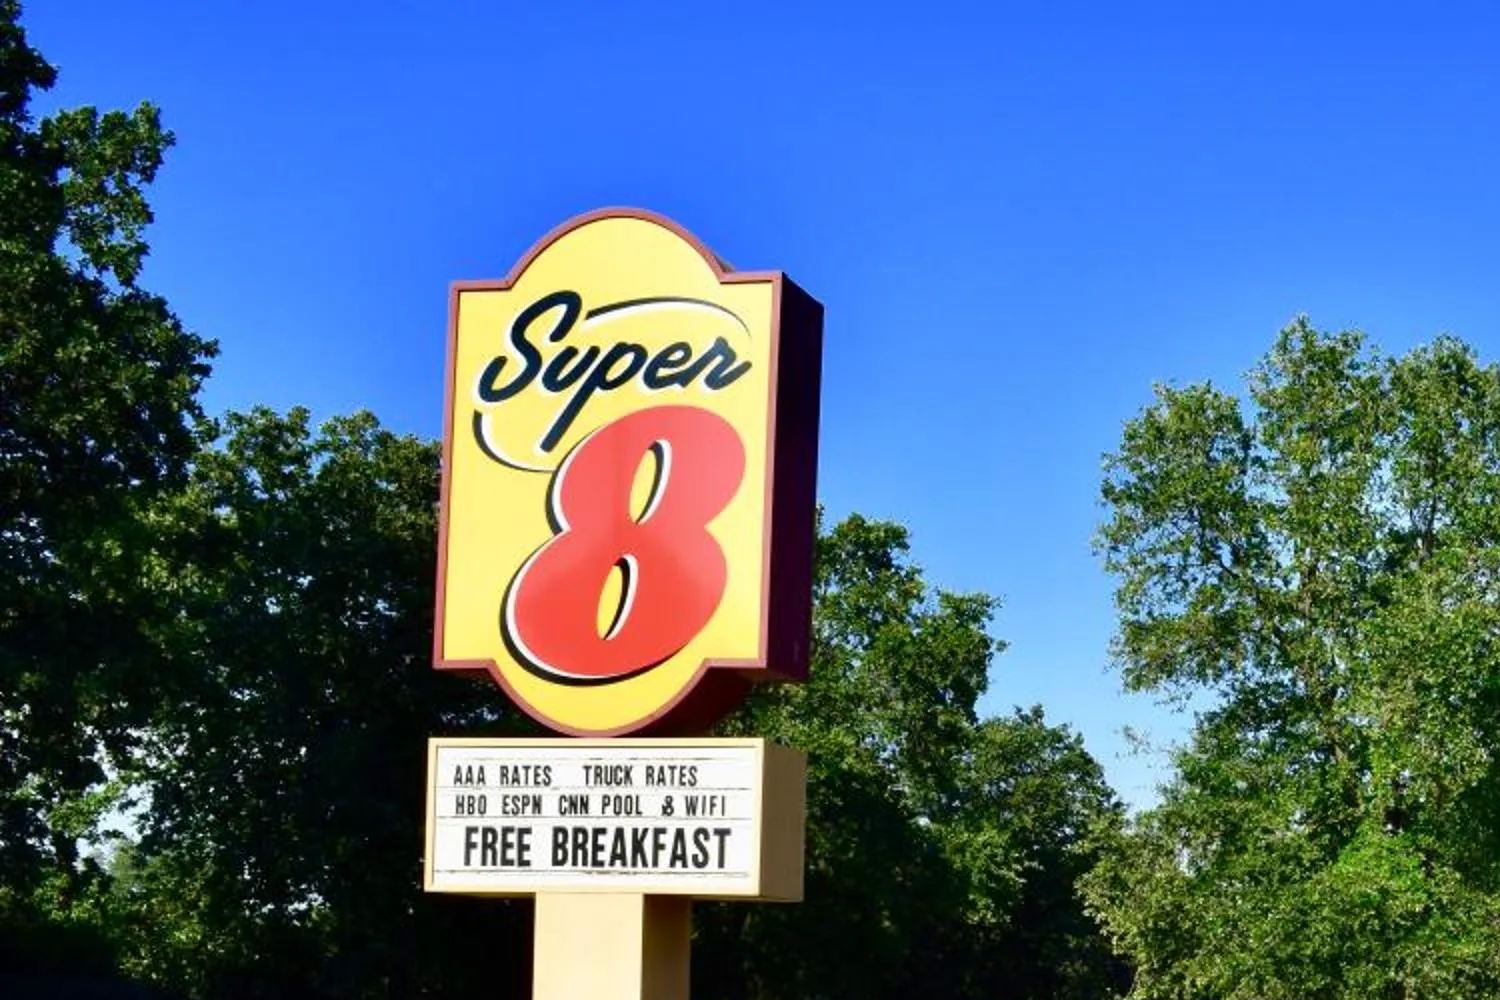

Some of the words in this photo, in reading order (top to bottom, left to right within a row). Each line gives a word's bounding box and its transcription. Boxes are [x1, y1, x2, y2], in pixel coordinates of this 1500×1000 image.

[478, 290, 752, 452] Super
[500, 404, 746, 686] 8
[453, 764, 486, 786] AAA
[500, 764, 552, 787] RATES
[582, 764, 634, 786] TRUCK
[645, 764, 698, 787] RATES
[455, 794, 487, 815] HBO
[502, 794, 542, 815] ESPN
[559, 795, 590, 815] CNN
[601, 795, 643, 816] POOL
[661, 794, 674, 816] &
[685, 795, 726, 817] WIFI
[464, 826, 532, 867] FREE
[551, 826, 732, 869] BREAKFAST
